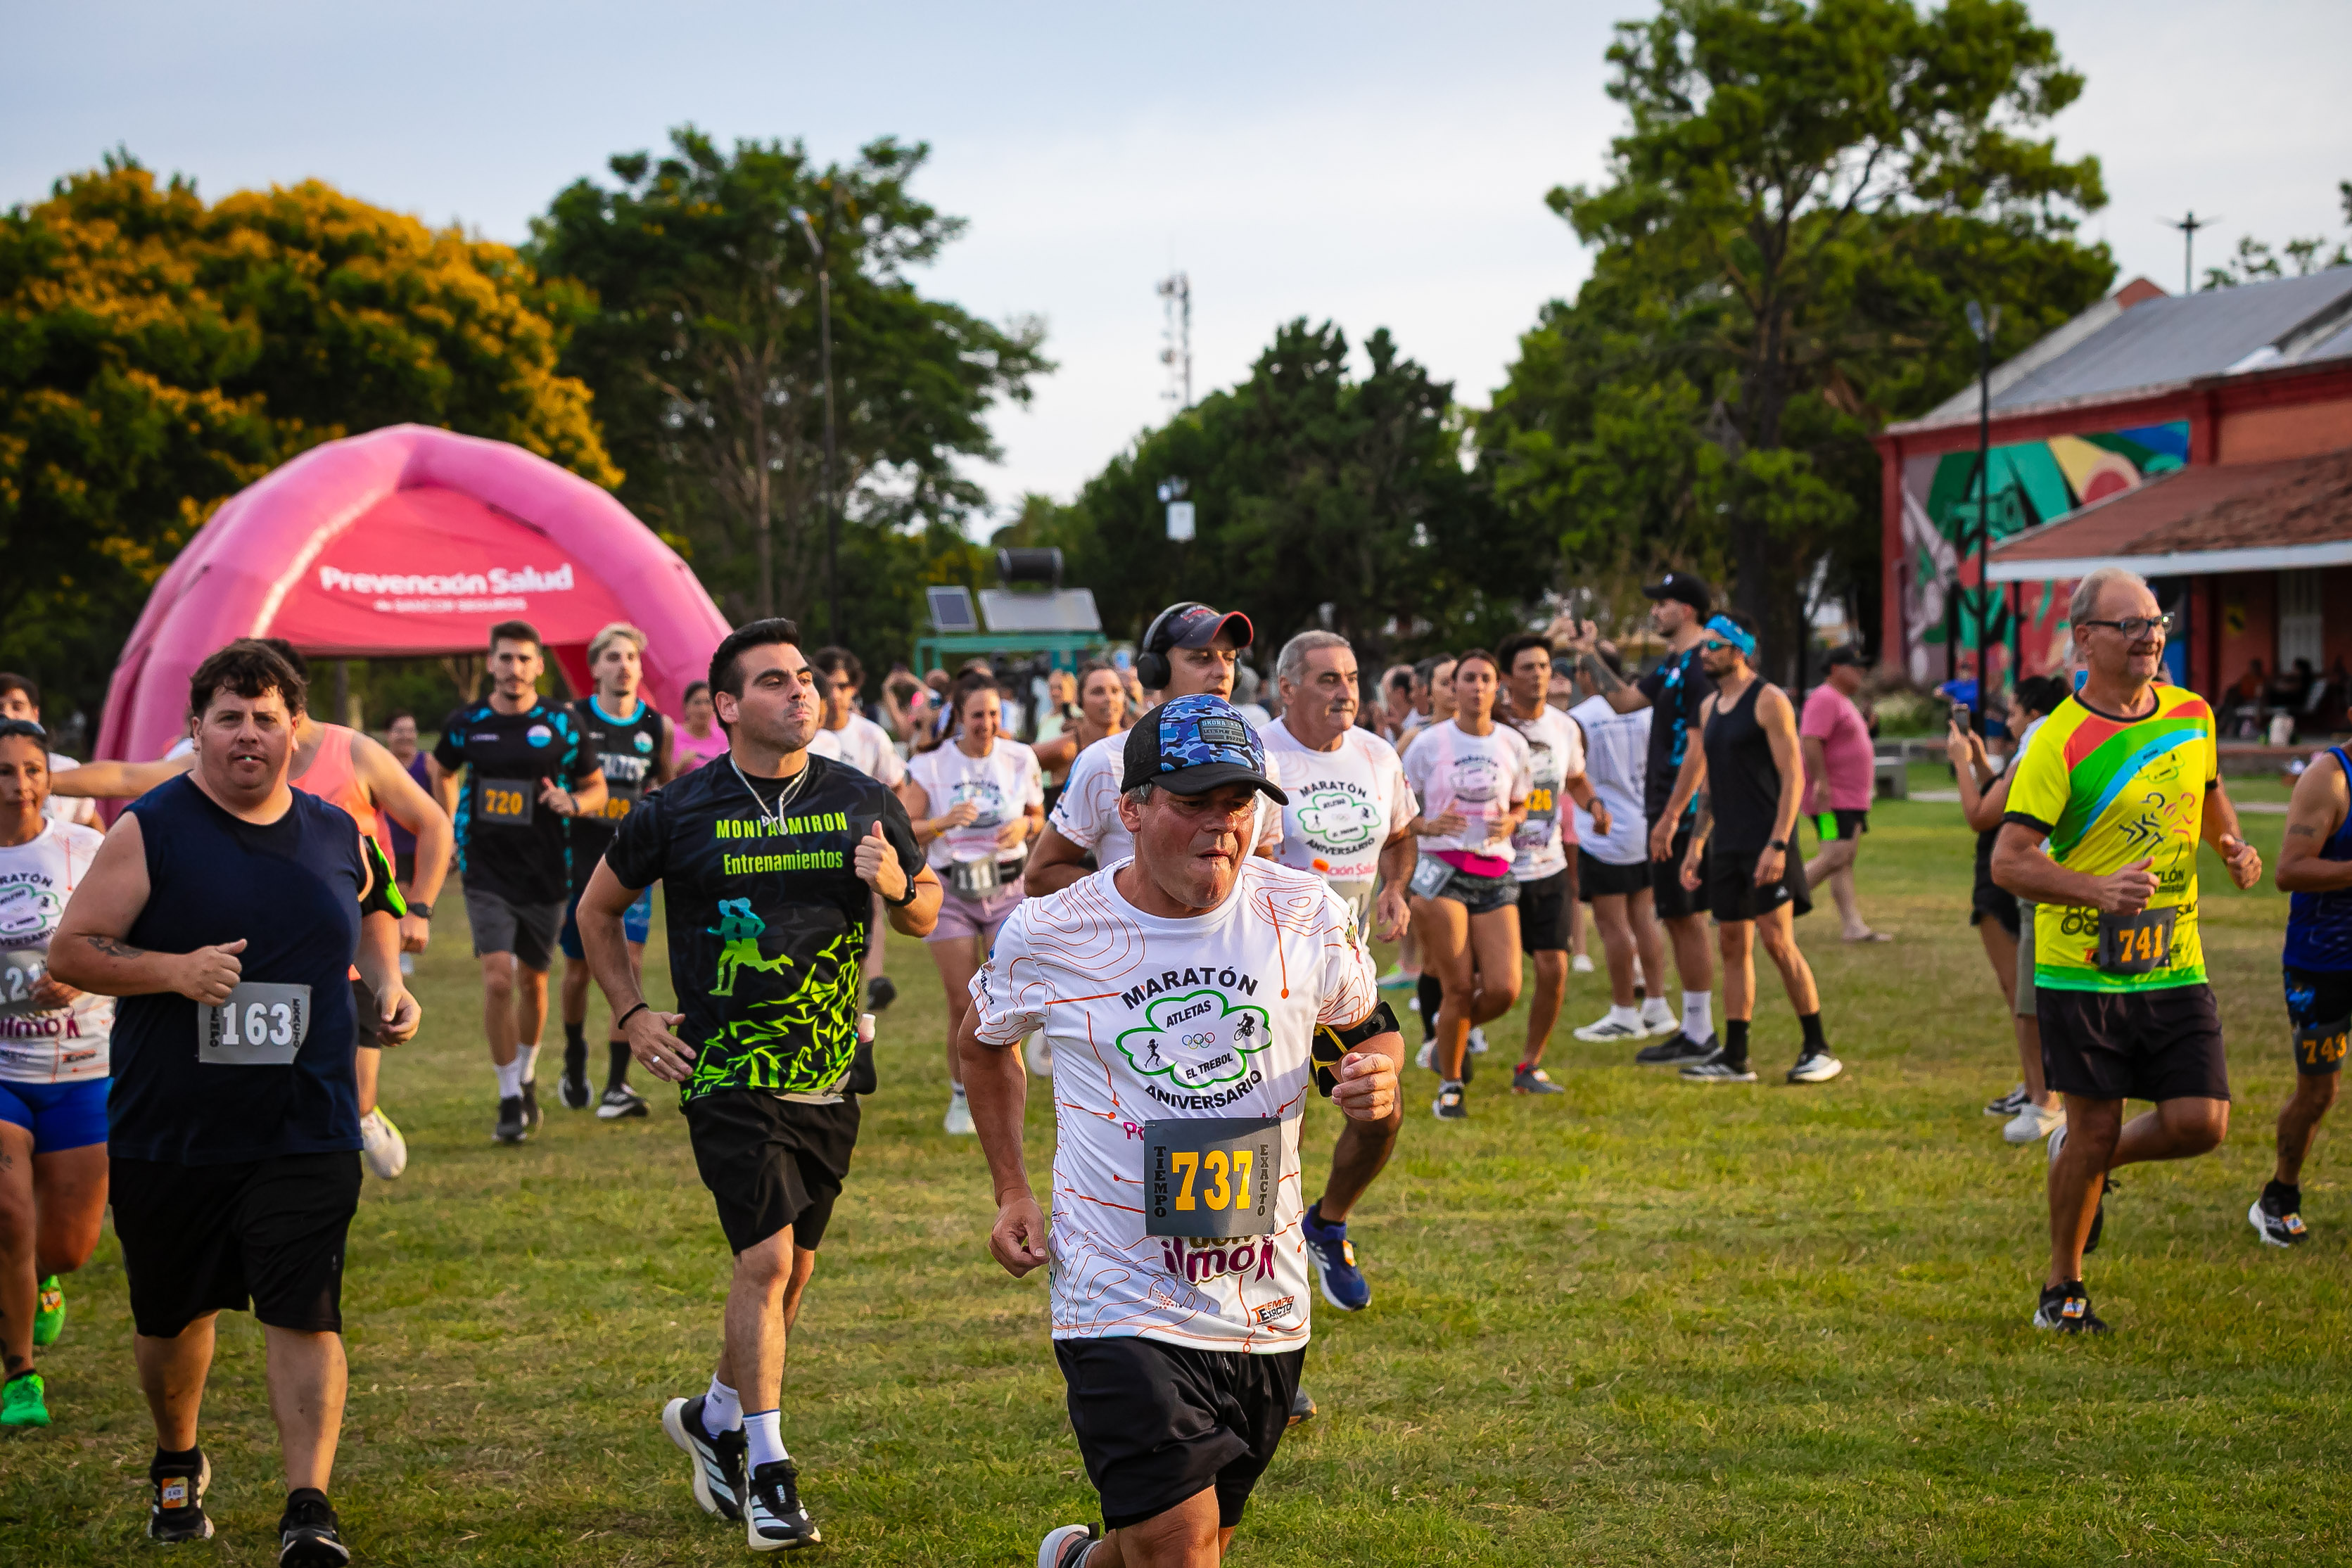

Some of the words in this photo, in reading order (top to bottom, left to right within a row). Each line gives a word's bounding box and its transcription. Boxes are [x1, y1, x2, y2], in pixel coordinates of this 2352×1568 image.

[319, 566, 487, 594] Prevención
[488, 563, 574, 594] Salud
[1299, 780, 1366, 798] MARATÓN
[716, 820, 762, 839] MONI
[1306, 838, 1375, 855] ANIVERSARIO
[723, 849, 844, 876] Entrenamientos
[2119, 924, 2163, 962] 741
[1121, 966, 1259, 1010] MARATÓN
[222, 1002, 293, 1046] 163
[292, 997, 301, 1048] EXACTO
[1166, 1000, 1212, 1028] ATLETAS
[1185, 1069, 1197, 1080] EL
[1197, 1053, 1233, 1075] TREBOL
[1145, 1070, 1262, 1110] ANIVERSARIO
[1153, 1145, 1168, 1218] TIEMPO
[1171, 1150, 1254, 1211] 737
[1257, 1145, 1269, 1217] EXACTO
[1251, 1295, 1295, 1322] TIEMPO
